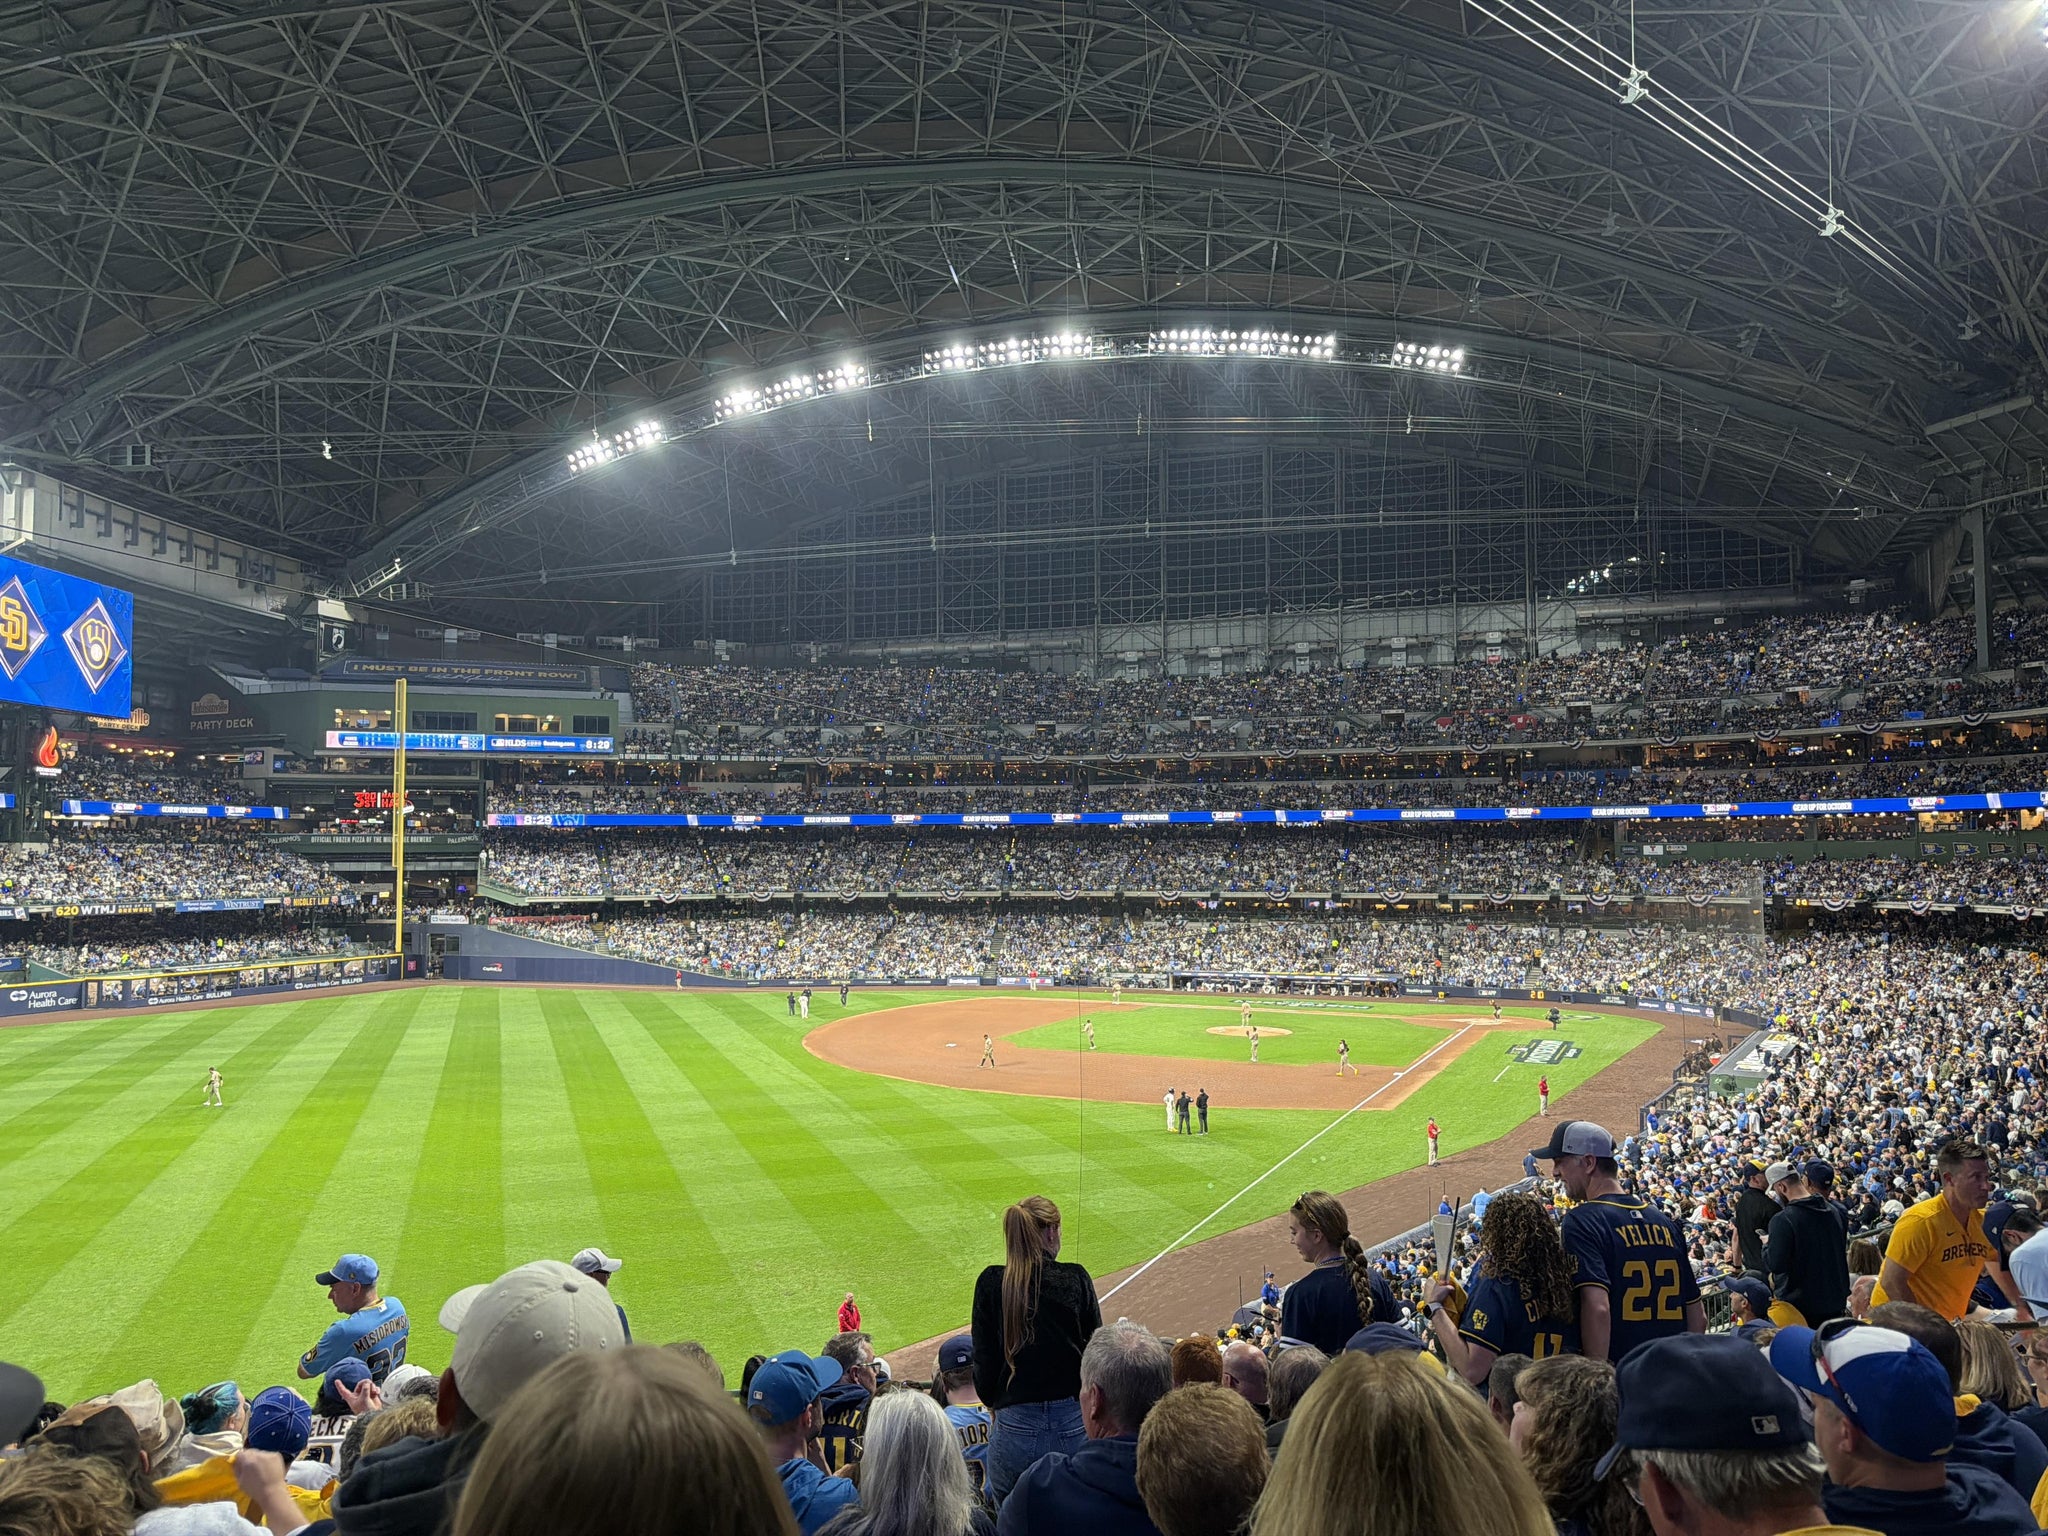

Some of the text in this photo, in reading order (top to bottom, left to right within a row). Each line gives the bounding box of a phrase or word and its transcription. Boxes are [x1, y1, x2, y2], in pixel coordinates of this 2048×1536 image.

[362, 664, 405, 672] MUST
[484, 668, 534, 677] FRONT
[191, 718, 254, 731] PARTY DECK
[586, 740, 610, 750] 8:29
[524, 815, 552, 824] 8:29
[293, 897, 330, 906] NICOLET LAW
[56, 905, 116, 916] 620 WTMJ
[342, 977, 363, 985] BULLPEN
[30, 990, 57, 998] Aurora
[206, 991, 232, 1000] BULLPEN
[1530, 990, 1544, 999] 20
[28, 997, 78, 1009] Health Care
[1616, 1224, 1674, 1248] YELICH
[1622, 1260, 1684, 1320] 22
